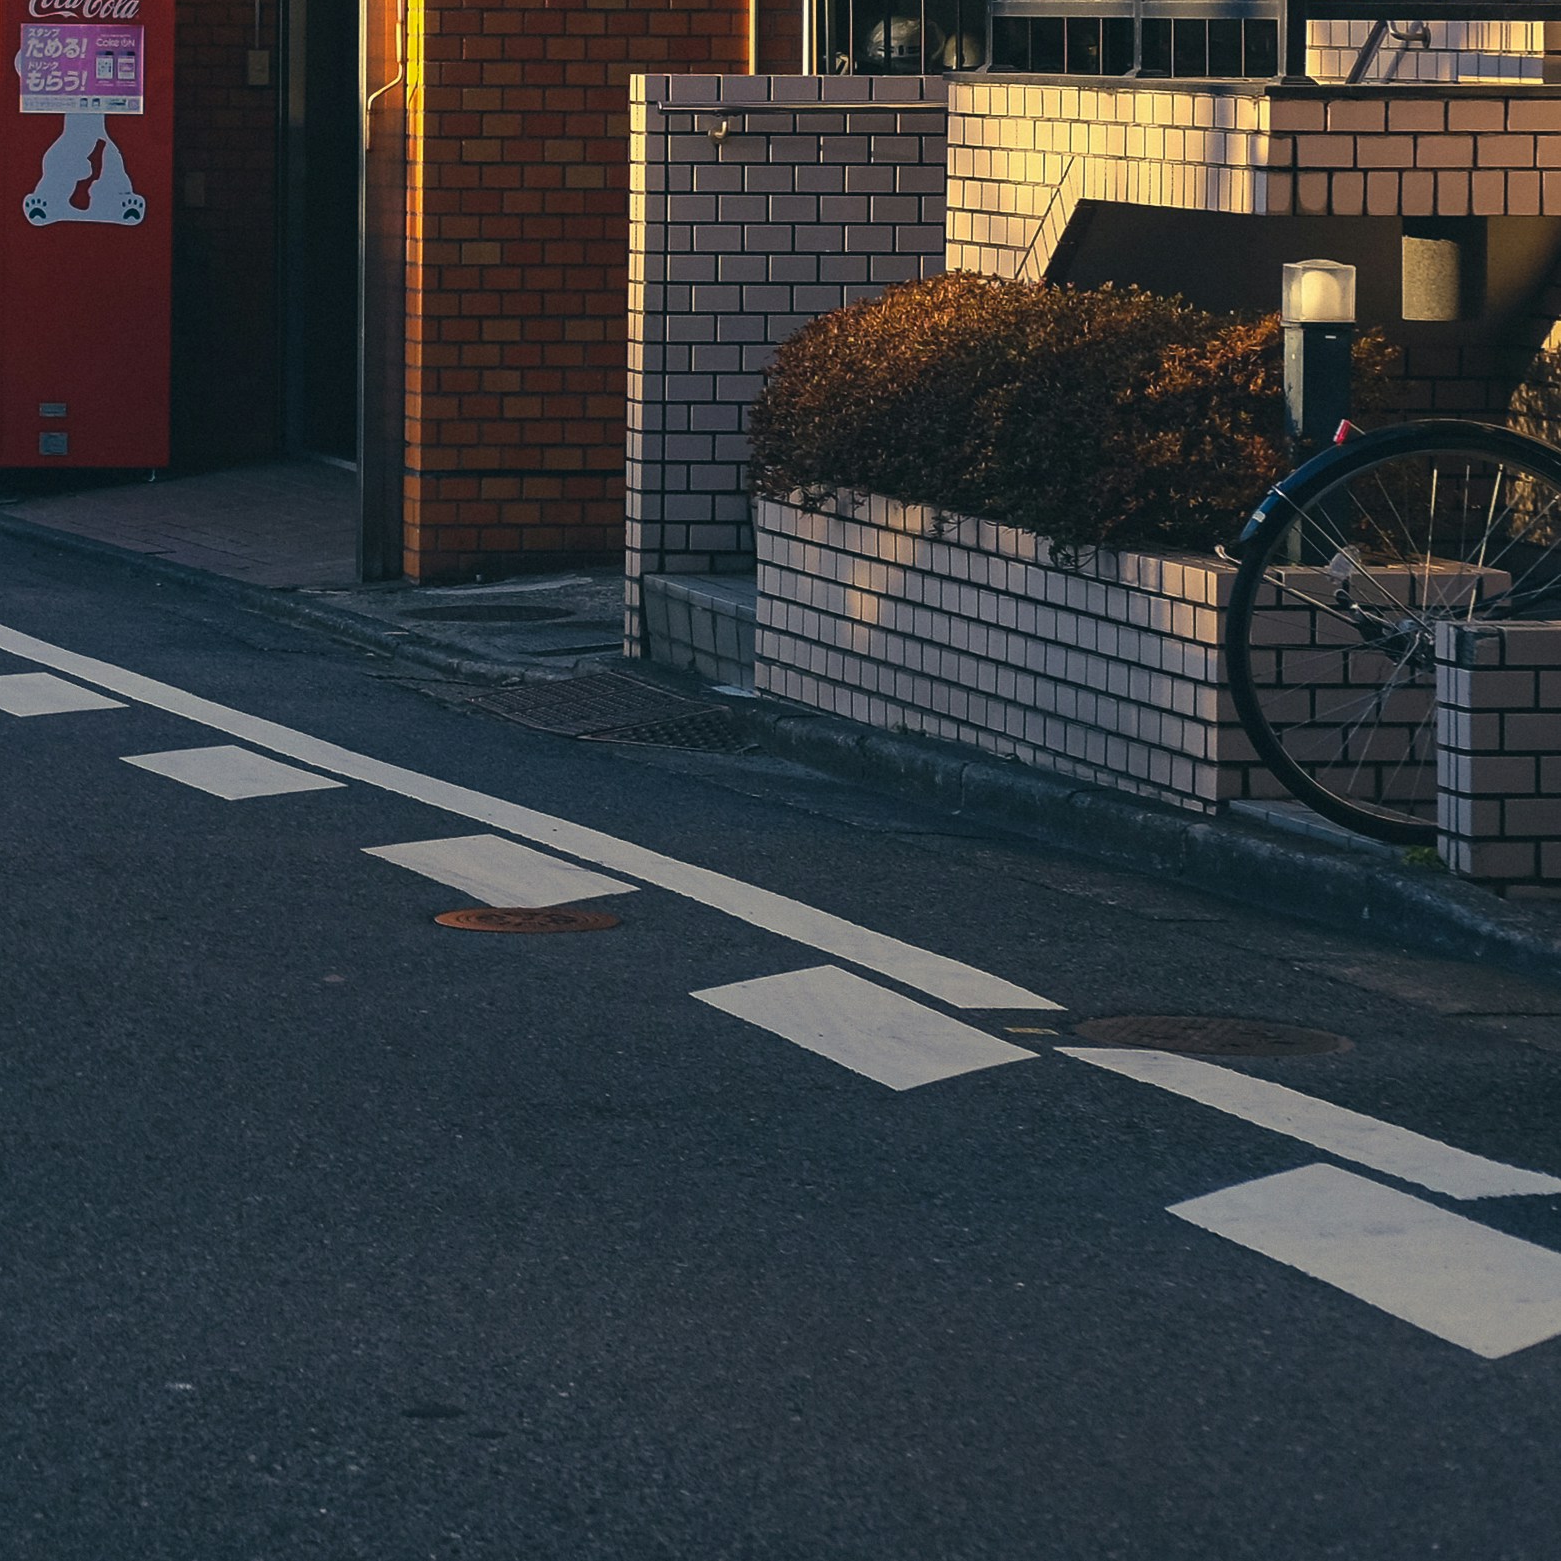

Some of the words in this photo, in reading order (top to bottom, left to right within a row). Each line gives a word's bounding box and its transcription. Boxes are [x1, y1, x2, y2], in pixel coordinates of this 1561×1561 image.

[25, 38, 88, 59] ためる!
[26, 70, 88, 92] もらう!
